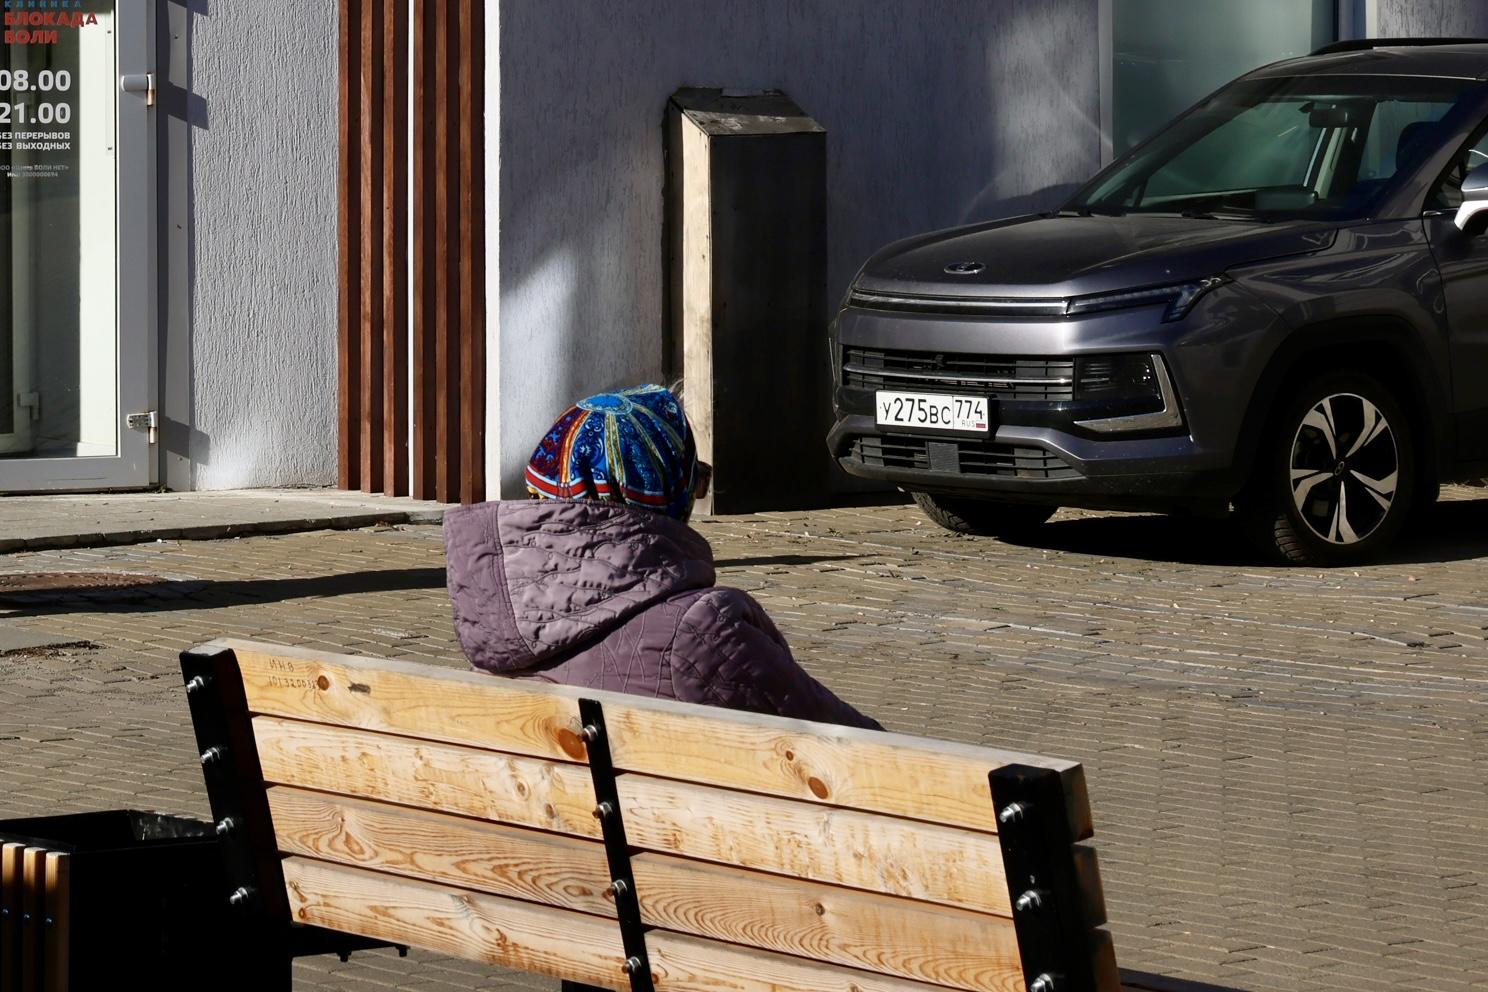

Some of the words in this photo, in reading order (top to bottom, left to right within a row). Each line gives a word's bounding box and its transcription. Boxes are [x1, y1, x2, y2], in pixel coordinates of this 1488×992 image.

[4, 0, 81, 8] КЛИНИКА
[4, 11, 98, 27] БЛОКАДА
[4, 30, 59, 44] БОЛИ
[14, 132, 71, 140] ПЕРЕРЫВОВ
[16, 142, 71, 151] ВЫХОДНЫХ
[883, 397, 951, 425] У275ВС
[955, 400, 983, 420] 774
[961, 420, 976, 428] RUS
